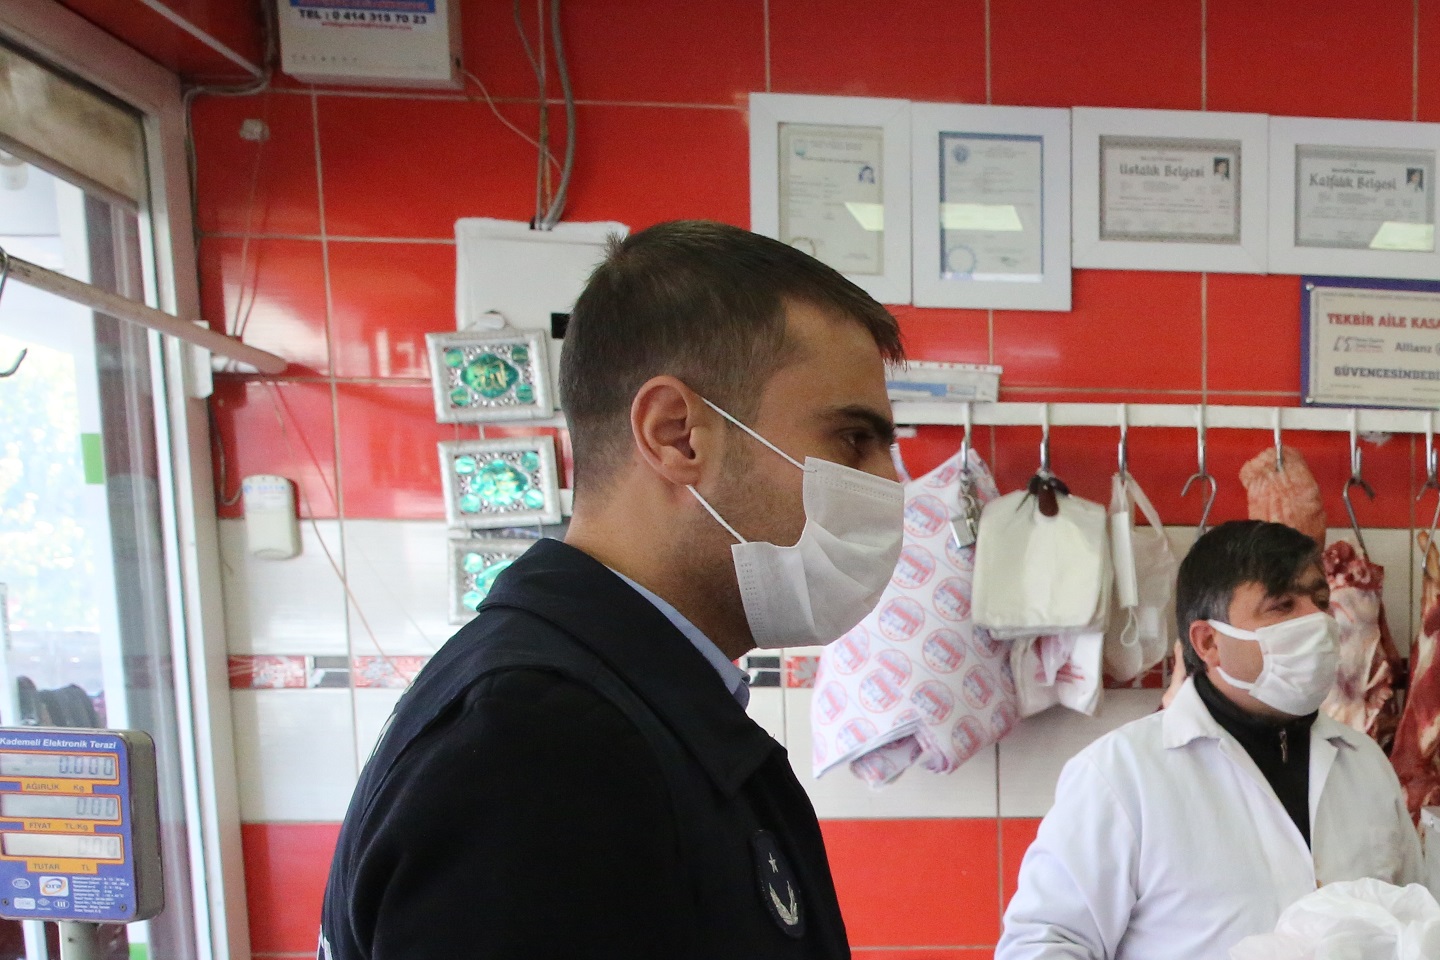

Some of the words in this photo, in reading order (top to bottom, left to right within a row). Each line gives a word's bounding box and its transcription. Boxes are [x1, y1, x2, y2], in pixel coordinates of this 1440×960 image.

[1327, 311, 1374, 326] TEKBİR
[1395, 342, 1433, 353] Allianz
[43, 740, 88, 748] Elektronik
